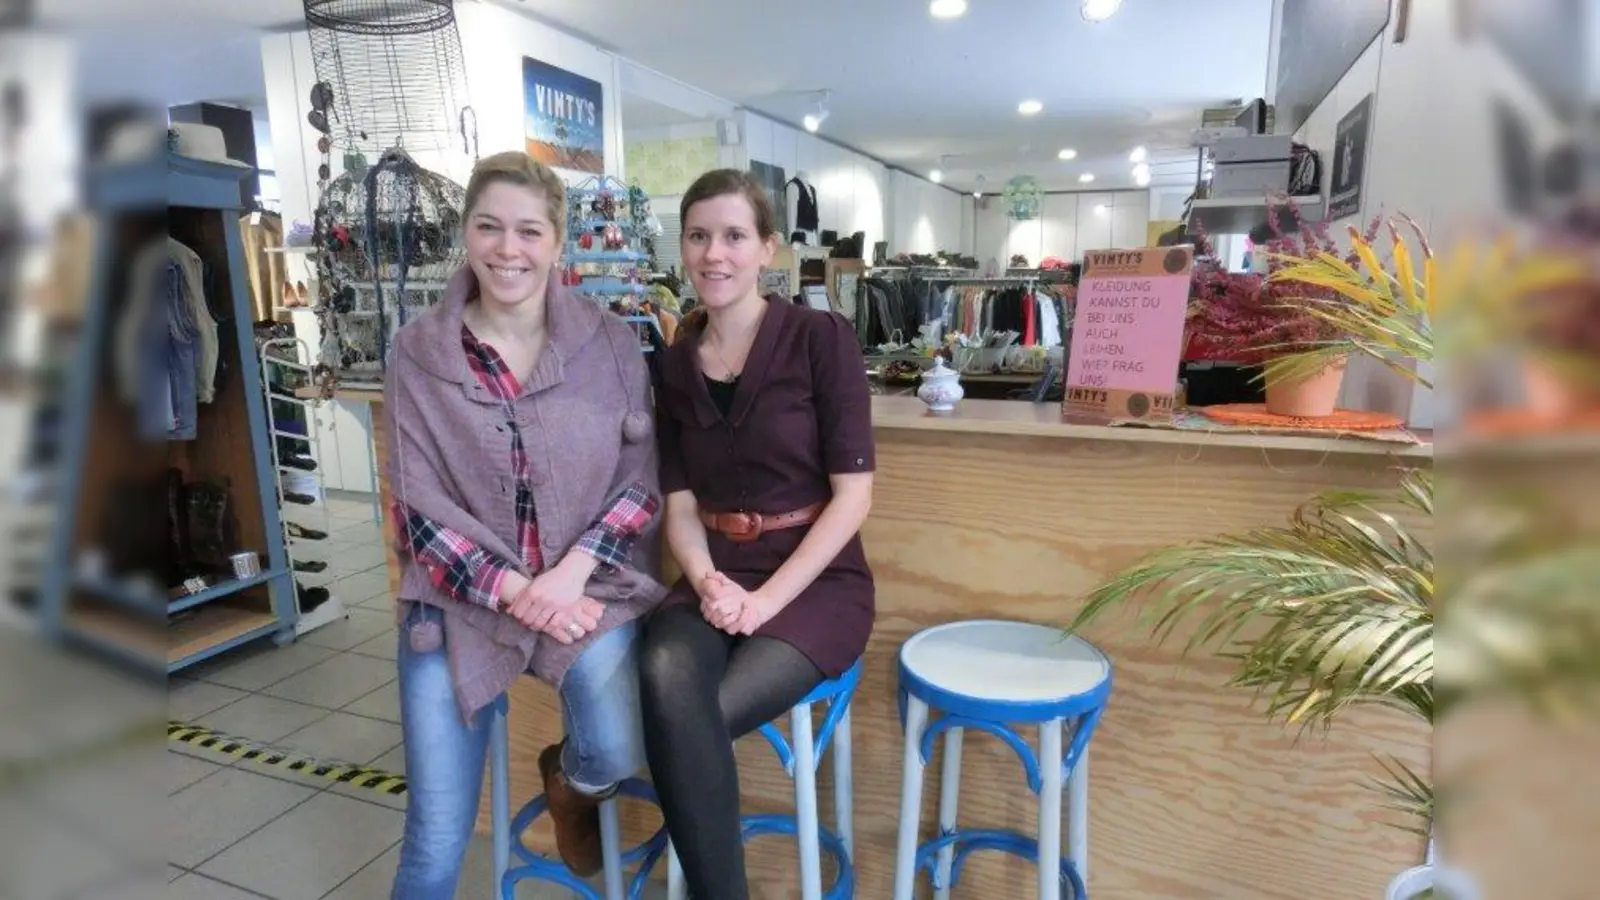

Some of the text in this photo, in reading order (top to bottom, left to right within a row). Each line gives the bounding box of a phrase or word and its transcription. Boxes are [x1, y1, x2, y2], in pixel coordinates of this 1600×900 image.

[535, 83, 596, 127] VINTY'S
[1093, 251, 1144, 265] VINTY'S
[1091, 280, 1151, 292] KLEIDUNG
[1089, 296, 1161, 308] KANNST DU
[1087, 311, 1135, 323] BEI UNS
[1085, 328, 1118, 339] AUCH
[1083, 344, 1124, 355] LEIHEN
[1112, 361, 1144, 372] FRAG
